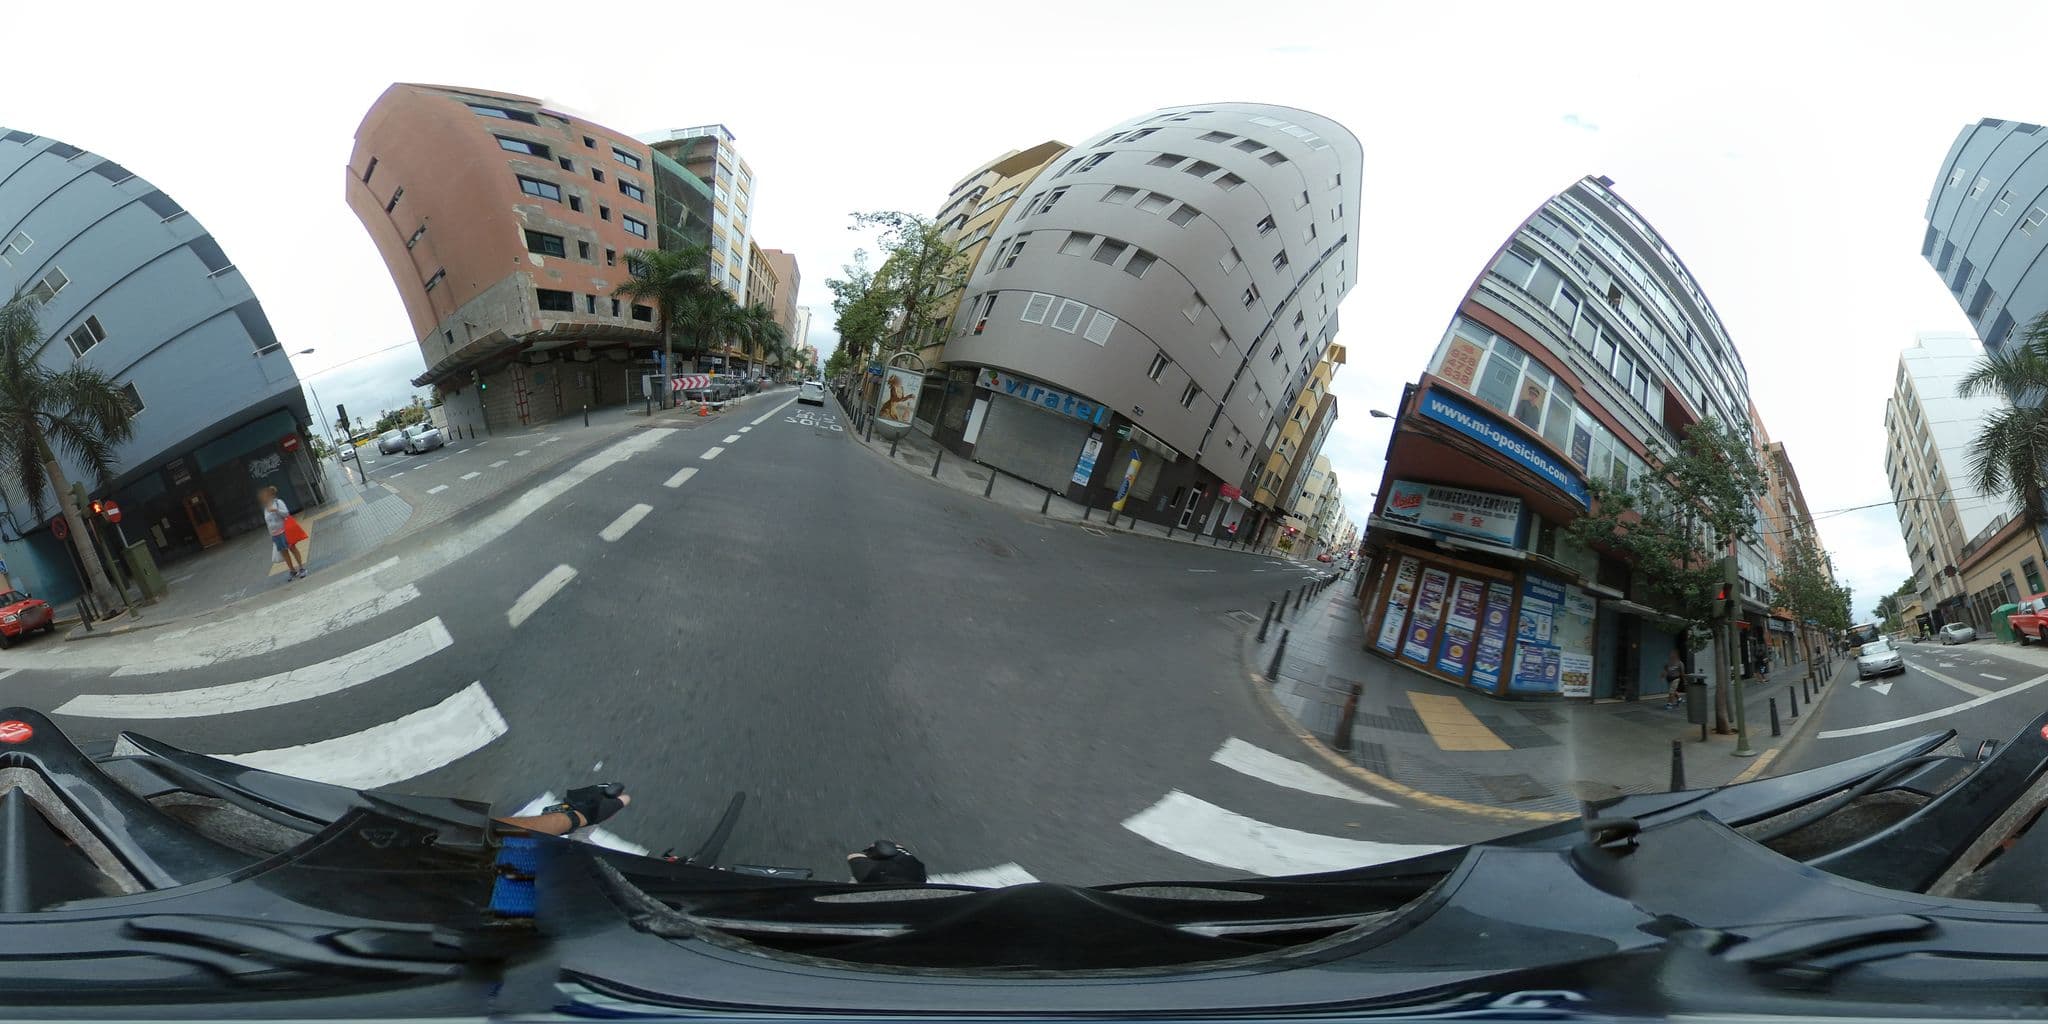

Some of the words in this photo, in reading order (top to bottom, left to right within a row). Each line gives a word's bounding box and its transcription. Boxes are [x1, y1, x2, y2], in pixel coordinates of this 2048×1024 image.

[1005, 377, 1105, 426] viratel
[1431, 399, 1568, 485] www.mi-oposicion.com
[1427, 487, 1483, 508] MINIMERCADO
[1482, 496, 1520, 514] ENRIQUE
